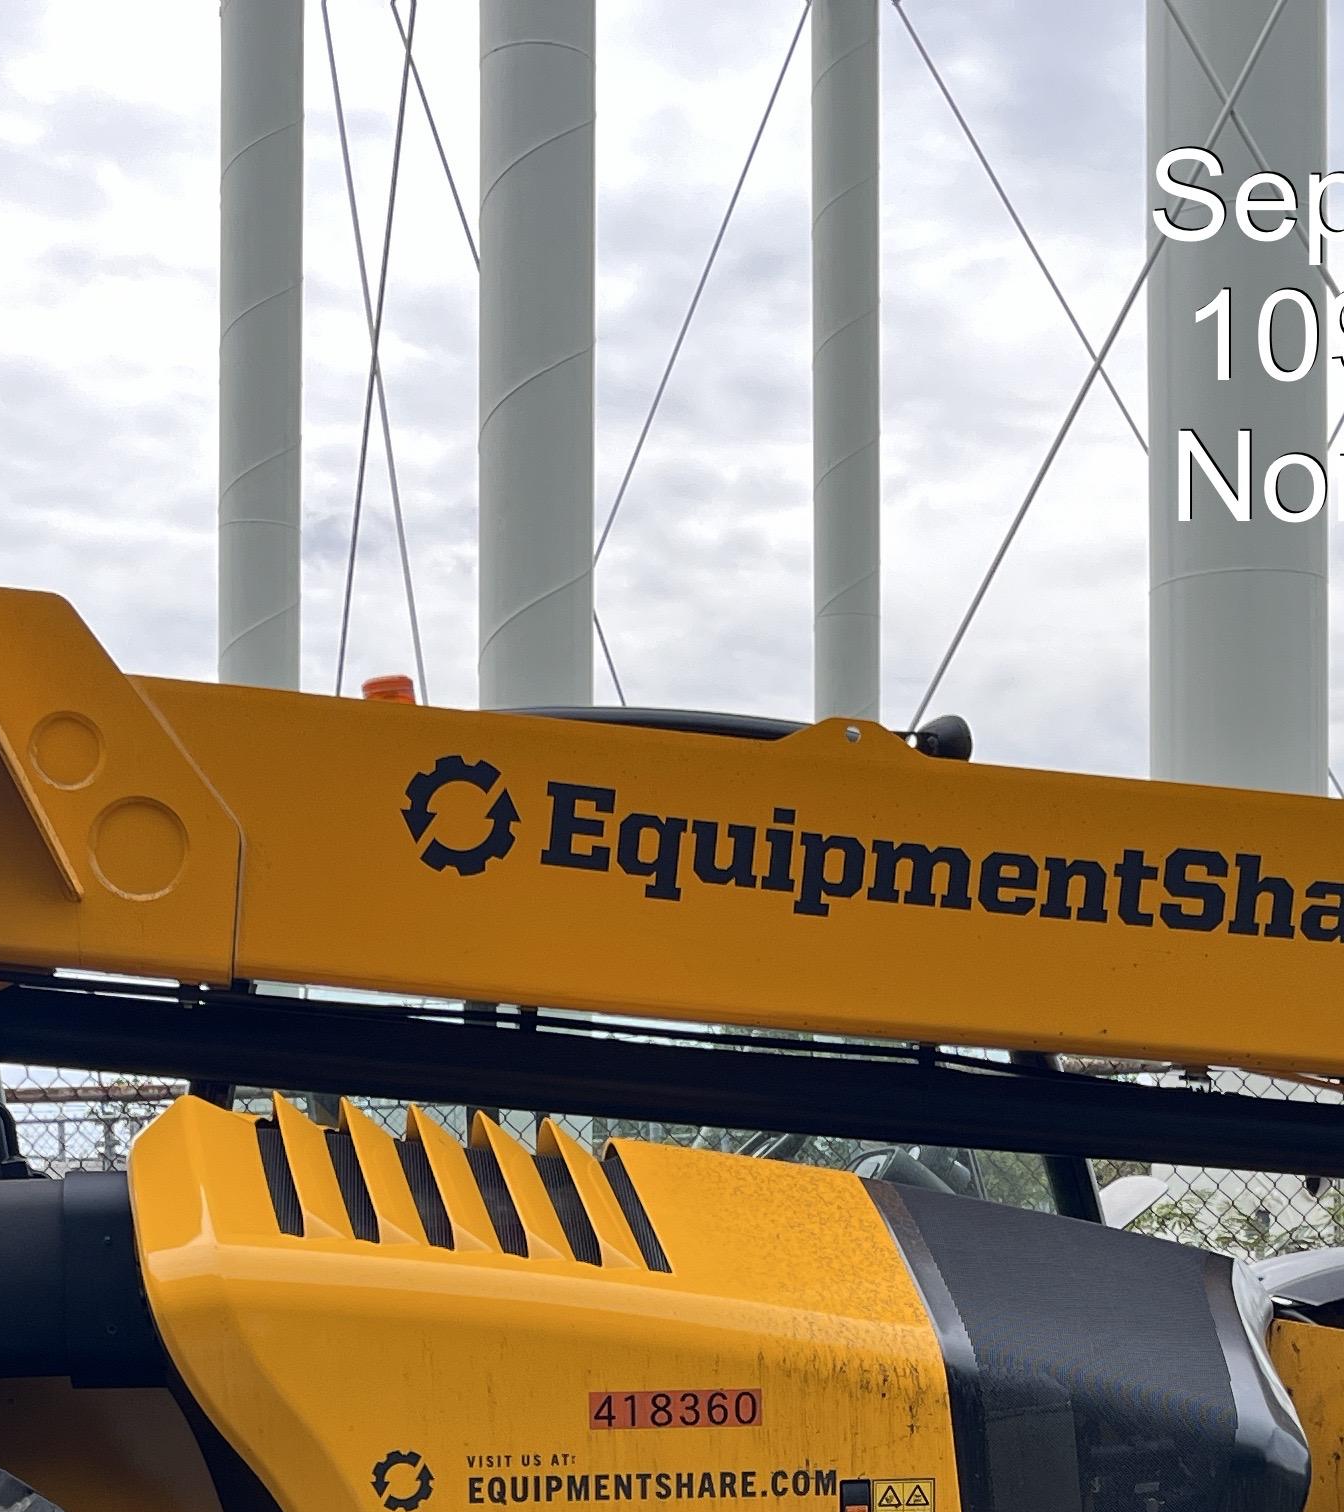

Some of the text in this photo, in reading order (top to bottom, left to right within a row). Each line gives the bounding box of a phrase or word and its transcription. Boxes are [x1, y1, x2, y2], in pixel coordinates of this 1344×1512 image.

[593, 1390, 758, 1428] 418360
[467, 1454, 512, 1468] VISIT
[521, 1453, 542, 1467] US
[468, 1469, 838, 1505] EQUIPMENTSHARE.COM
